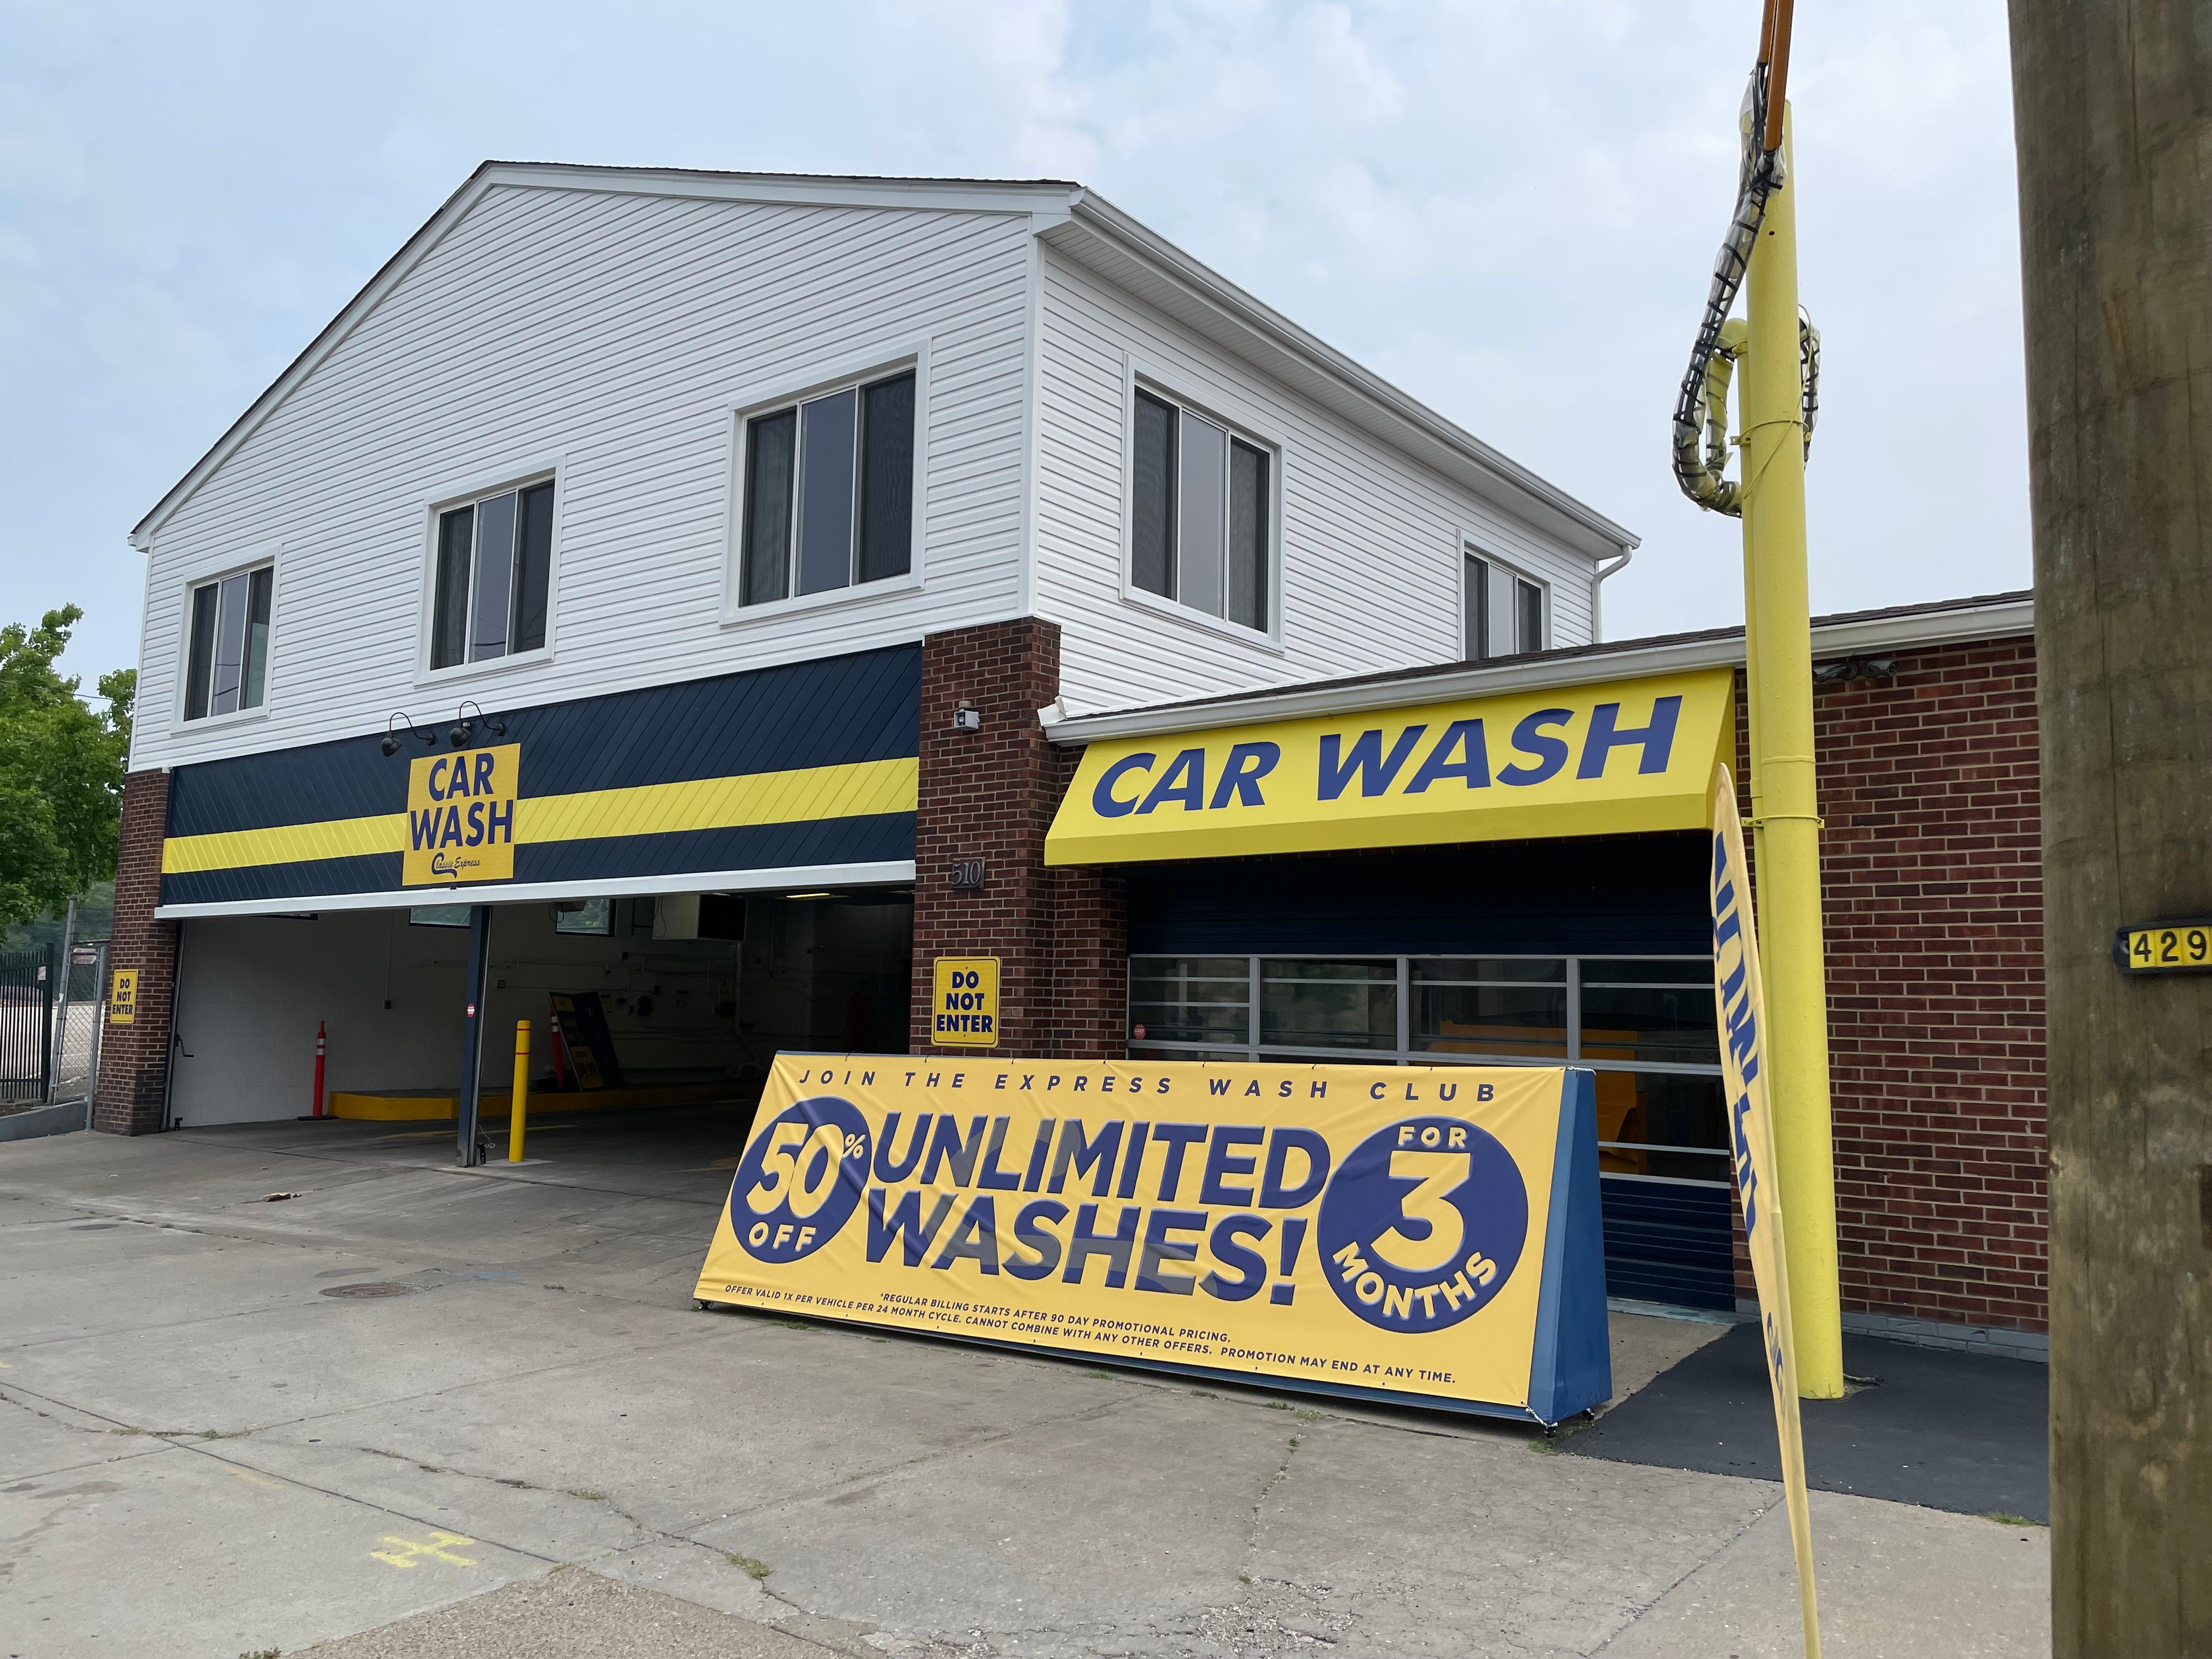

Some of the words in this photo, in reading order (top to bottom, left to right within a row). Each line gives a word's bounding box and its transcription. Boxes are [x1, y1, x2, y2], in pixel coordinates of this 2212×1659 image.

[1091, 741, 1281, 818] CAR
[1316, 695, 1683, 802] WASH
[428, 753, 494, 802] CAR
[410, 799, 514, 851] WASH
[454, 856, 480, 870] Express
[951, 861, 981, 886] 510
[2134, 930, 2207, 962] 429
[120, 978, 130, 989] DO
[952, 970, 979, 989] DO
[112, 1004, 133, 1014] ENTER
[116, 991, 131, 1002] NOT
[946, 992, 985, 1011] NOT
[936, 1014, 992, 1033] ENTER
[799, 1070, 876, 1086] JOIN
[905, 1072, 966, 1088] THE
[994, 1074, 1171, 1094] EXPRESS
[1210, 1079, 1328, 1099] WASH
[1370, 1082, 1495, 1102] CLUB
[1398, 1125, 1467, 1148] FOR
[873, 1111, 1331, 1209] UNLIMITED
[1370, 1150, 1471, 1271] 3
[748, 1221, 817, 1253] OFF
[865, 1187, 1307, 1306] WASHES!
[1331, 1240, 1497, 1320] MONTHS
[725, 1284, 753, 1296] OFFER
[756, 1289, 781, 1299] VALID
[783, 1293, 793, 1301] 1X
[795, 1295, 813, 1304] PER
[816, 1297, 853, 1309] VEHICLE
[856, 1302, 874, 1312] PER
[890, 1307, 926, 1318] MONTH
[928, 1312, 962, 1324] CYCLE.
[966, 1316, 1009, 1329] CANNOT
[1011, 1322, 1059, 1335] COMBINE
[1063, 1328, 1091, 1340] WITH
[1094, 1331, 1119, 1343] ANY
[1122, 1335, 1160, 1348] OTHER
[1164, 1340, 1212, 1355] OFFERS.
[1220, 1347, 1296, 1365] PROMOTION
[1300, 1356, 1327, 1368] MAY
[1331, 1360, 1358, 1372] END
[1363, 1365, 1380, 1374] AT
[1384, 1367, 1414, 1378] ANY
[1419, 1370, 1456, 1384] TIME.
[930, 1299, 969, 1311] BILLING
[972, 1304, 1011, 1317] STARTS
[1013, 1310, 1047, 1321] AFTER
[1051, 1314, 1064, 1323] 90
[1068, 1316, 1090, 1326] DAY
[1092, 1318, 1175, 1336] PROMOTIONAL
[1179, 1328, 1231, 1342] PRICING.
